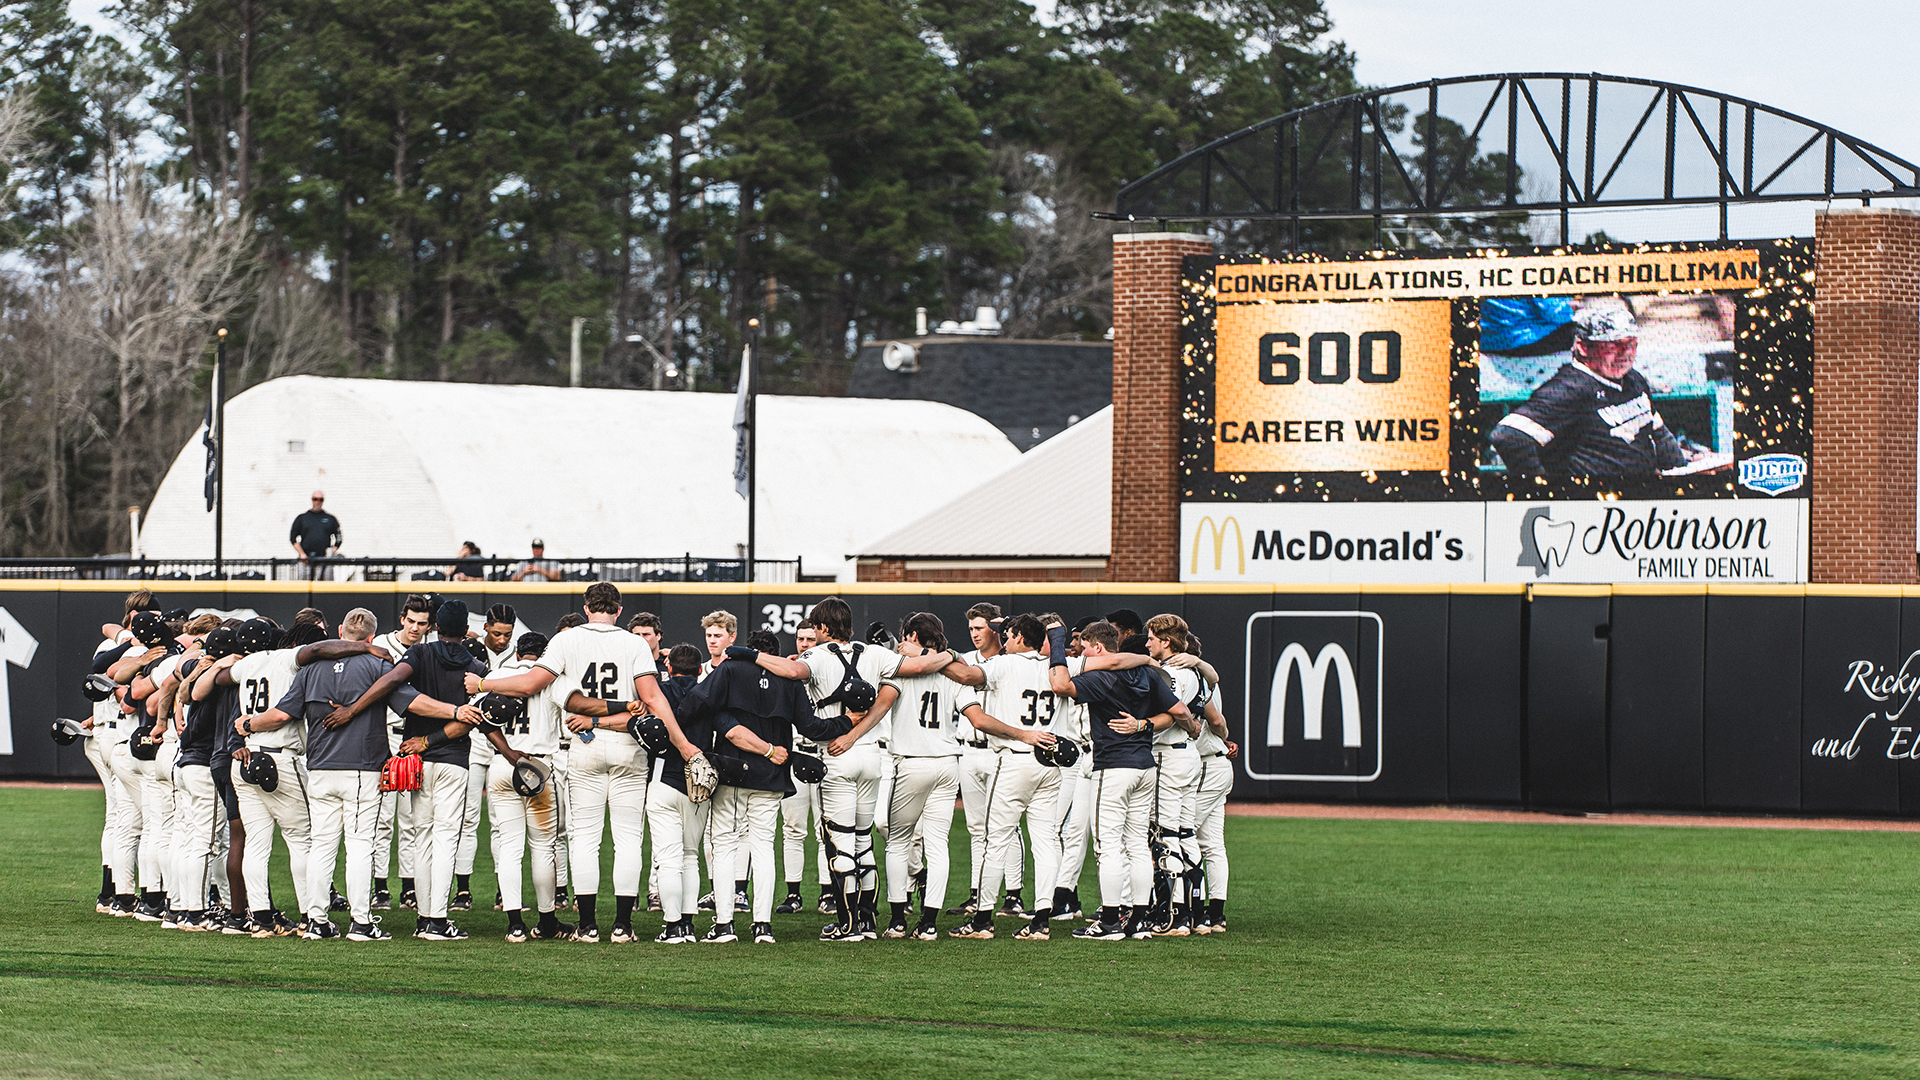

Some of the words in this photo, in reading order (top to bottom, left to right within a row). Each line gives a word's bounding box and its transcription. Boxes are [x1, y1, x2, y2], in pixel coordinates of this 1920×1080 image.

[1218, 270, 1470, 294] CONGRATULATIONS,
[1479, 268, 1513, 287] HC
[1522, 266, 1609, 286] COACH
[1619, 261, 1758, 284] HOLLIMAN
[1258, 330, 1401, 385] 600
[1220, 420, 1345, 444] CAREER
[1355, 418, 1440, 442] WINS
[1251, 529, 1464, 561] McDonald's
[1582, 506, 1771, 560] Robinson
[1638, 557, 1698, 578] FAMILY
[1705, 556, 1774, 578] DENTAL
[246, 677, 270, 715] 38
[581, 662, 618, 699] 42
[919, 690, 940, 729] 11
[1020, 689, 1056, 727] 33
[1811, 712, 1877, 760] and
